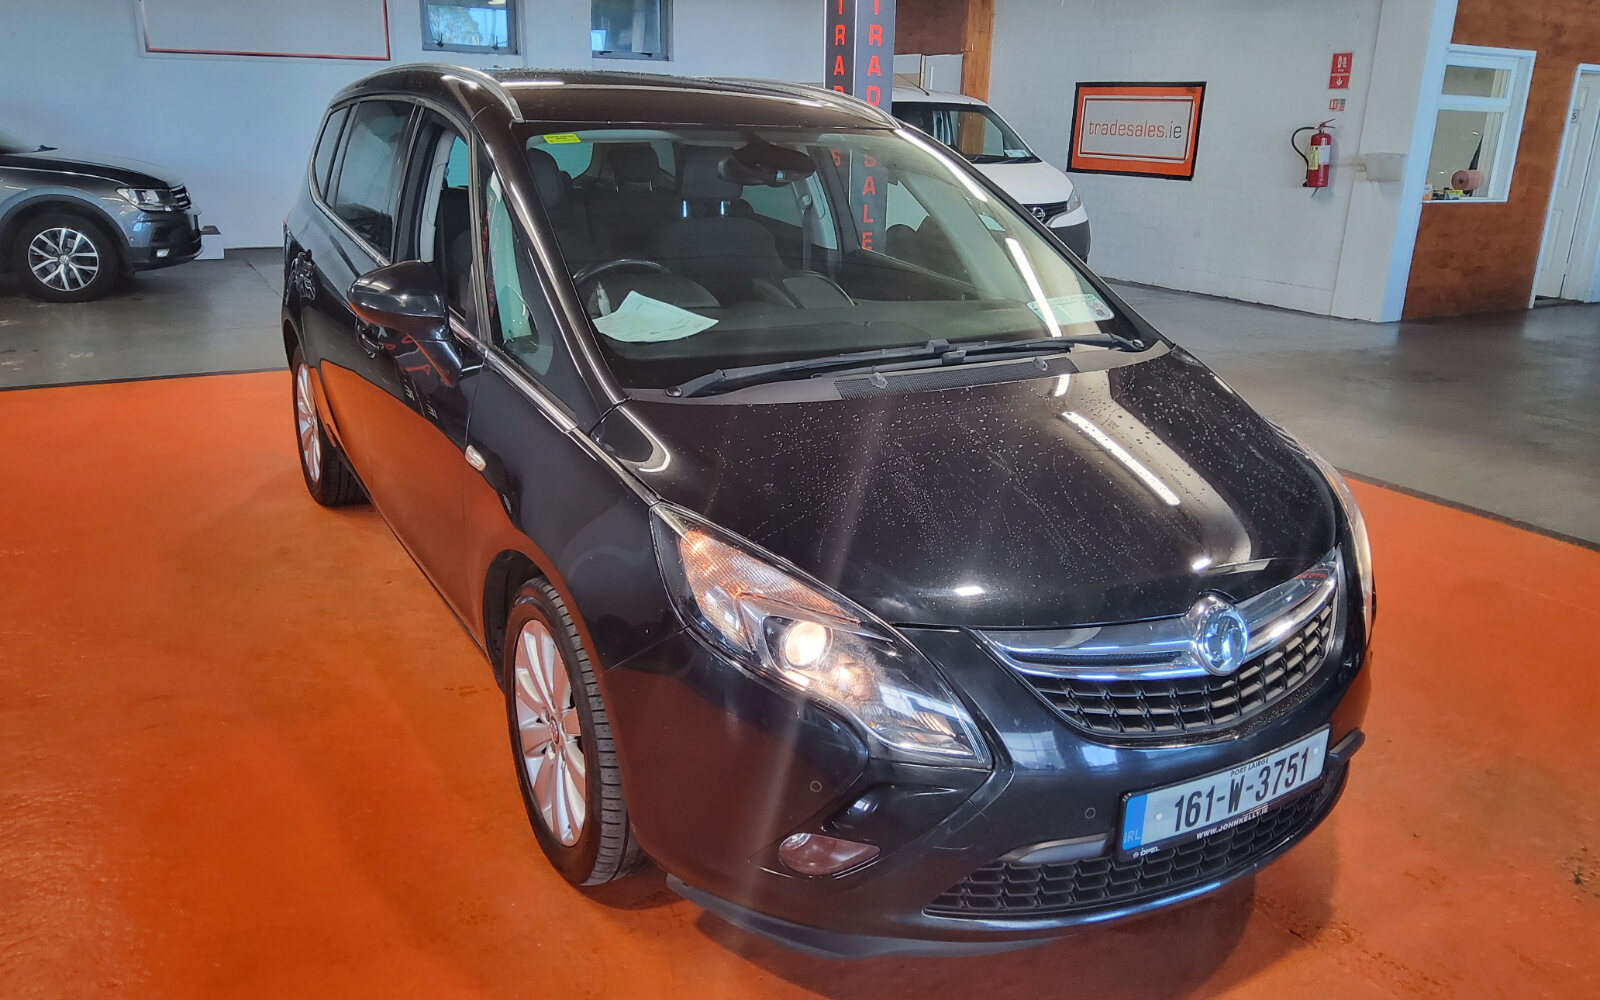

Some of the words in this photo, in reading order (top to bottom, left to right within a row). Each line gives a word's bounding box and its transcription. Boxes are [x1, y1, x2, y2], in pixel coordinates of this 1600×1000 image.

[1088, 119, 1182, 139] tradesales.ie
[1174, 747, 1310, 832] 161-W-3751
[1196, 804, 1269, 840] WWW.JOHNKELLY.IE
[1123, 829, 1141, 844] IRL
[1140, 846, 1160, 856] OPEL
